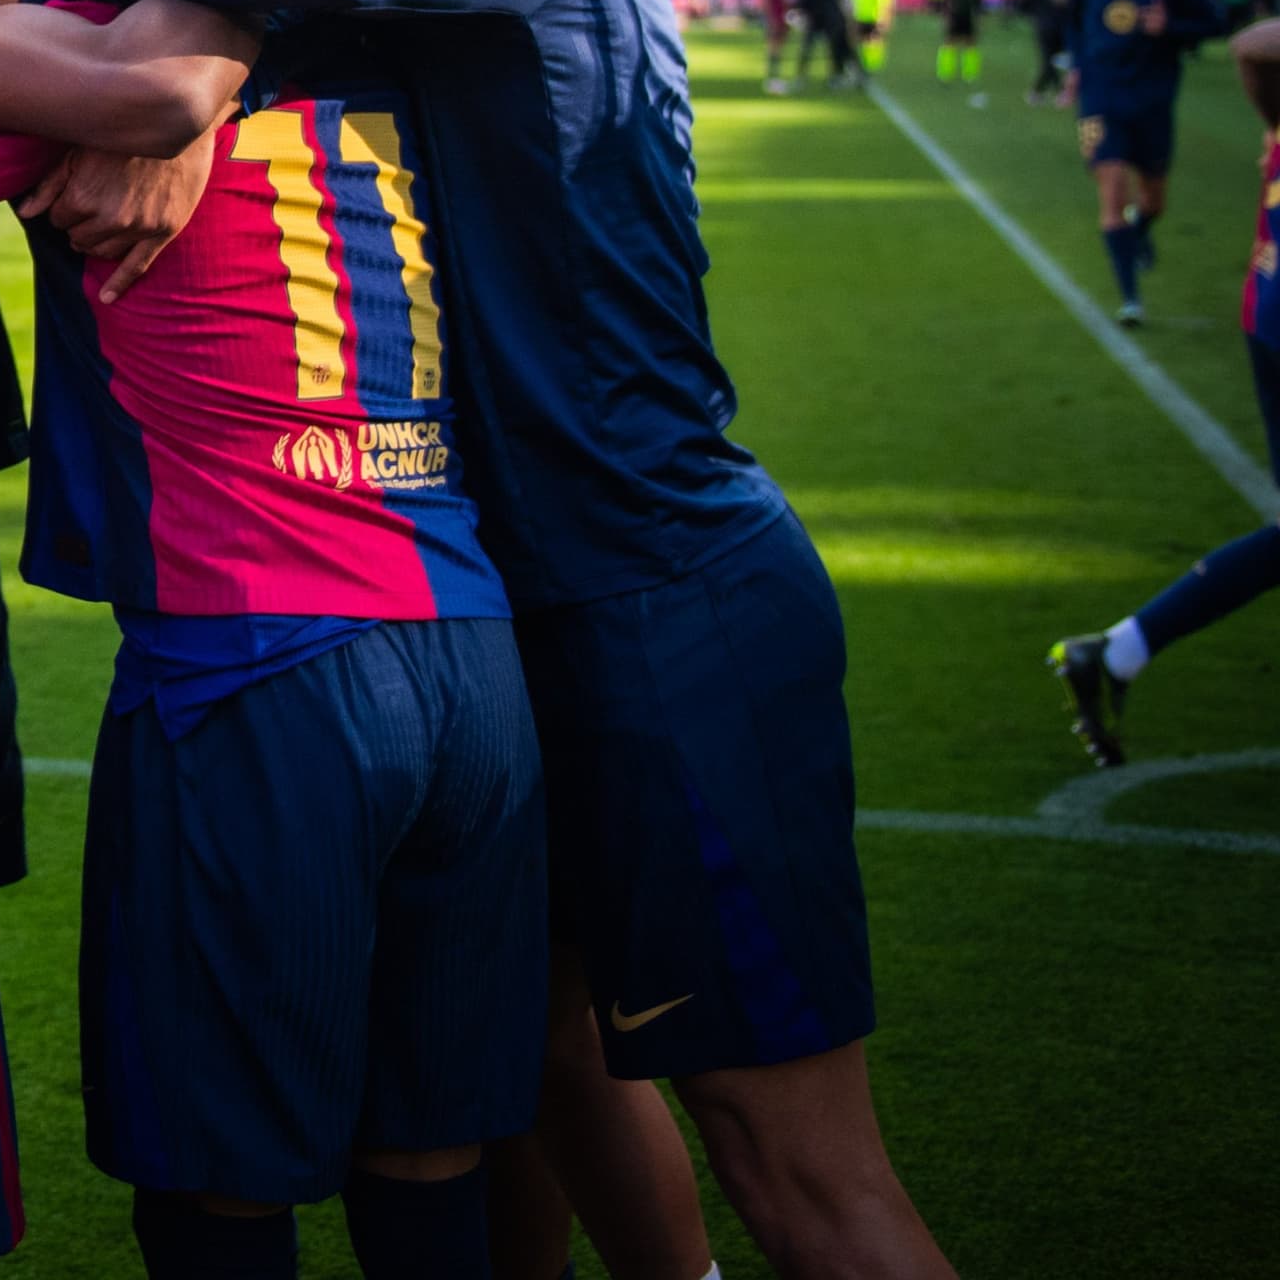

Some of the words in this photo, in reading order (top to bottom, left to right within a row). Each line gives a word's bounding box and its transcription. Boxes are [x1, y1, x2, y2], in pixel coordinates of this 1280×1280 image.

[230, 109, 441, 401] 11
[357, 421, 443, 451] UNHCR
[360, 446, 449, 481] ACNUR
